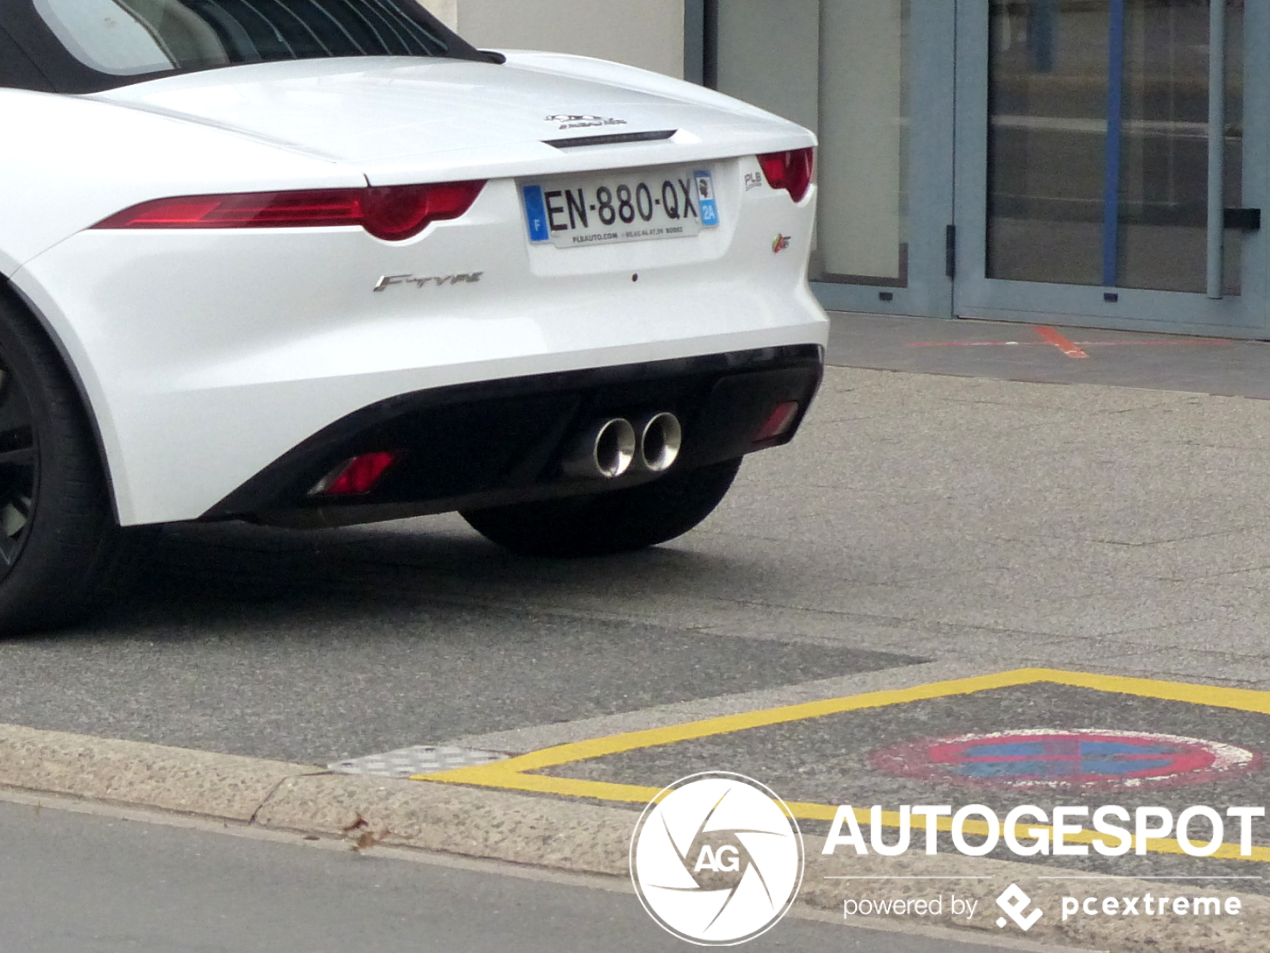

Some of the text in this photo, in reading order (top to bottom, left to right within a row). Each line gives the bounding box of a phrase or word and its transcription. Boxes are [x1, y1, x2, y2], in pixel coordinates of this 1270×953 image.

[543, 178, 699, 232] EN-880-QX
[702, 205, 716, 220] 2A
[533, 219, 541, 232] F
[572, 232, 619, 244] PLBAUTO.COM
